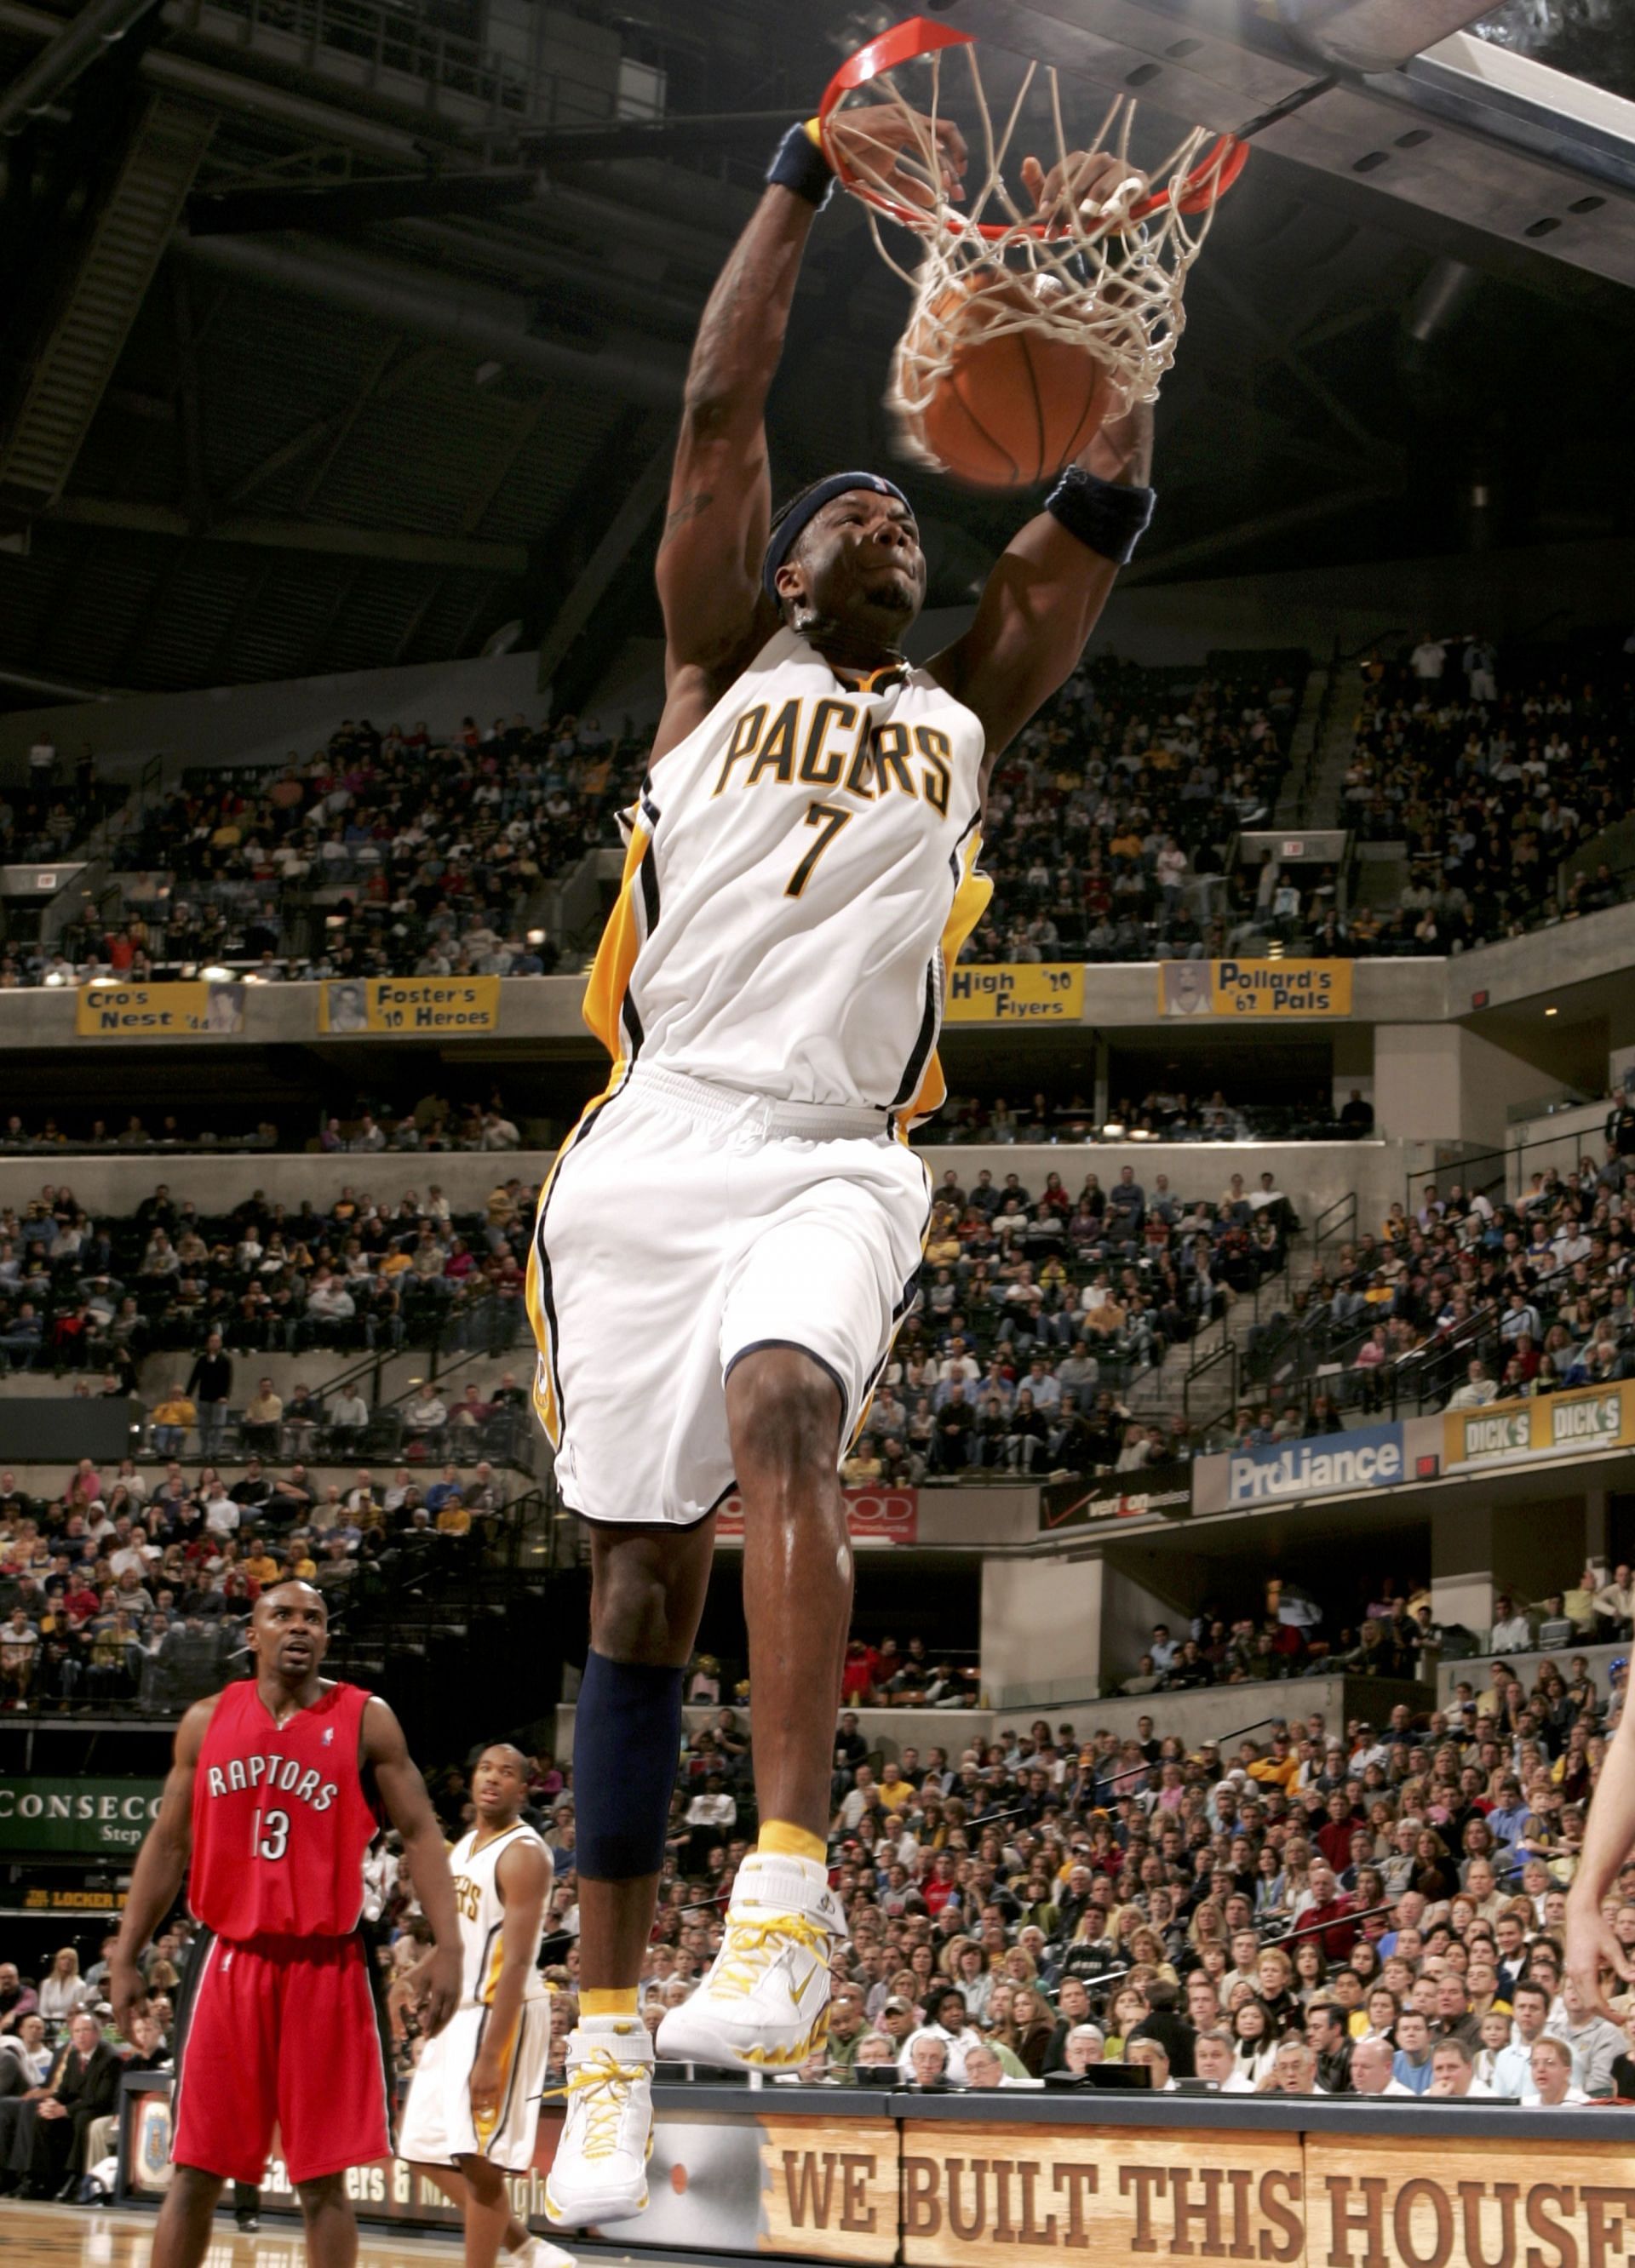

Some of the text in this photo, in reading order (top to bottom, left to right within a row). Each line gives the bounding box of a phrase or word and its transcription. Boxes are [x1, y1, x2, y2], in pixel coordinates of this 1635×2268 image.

[783, 799, 852, 898] 7
[952, 971, 1014, 999] High
[1219, 962, 1331, 990] Pollard's
[87, 991, 149, 1008] Cro's
[377, 984, 476, 1006] Foster's
[995, 994, 1064, 1017] Flyers
[1273, 988, 1330, 1011] Pals
[100, 1011, 174, 1028] Nest
[416, 1007, 490, 1027] Heroes
[1230, 1443, 1400, 1501] ProLiance
[1088, 1492, 1149, 1518] verizon
[209, 1755, 339, 1812] RAPTORS
[100, 1824, 142, 1845] Step
[252, 1808, 290, 1860] 13
[52, 1892, 114, 1907] LOCKER
[783, 2150, 1635, 2268] WE BUILT THIS HOUSE
